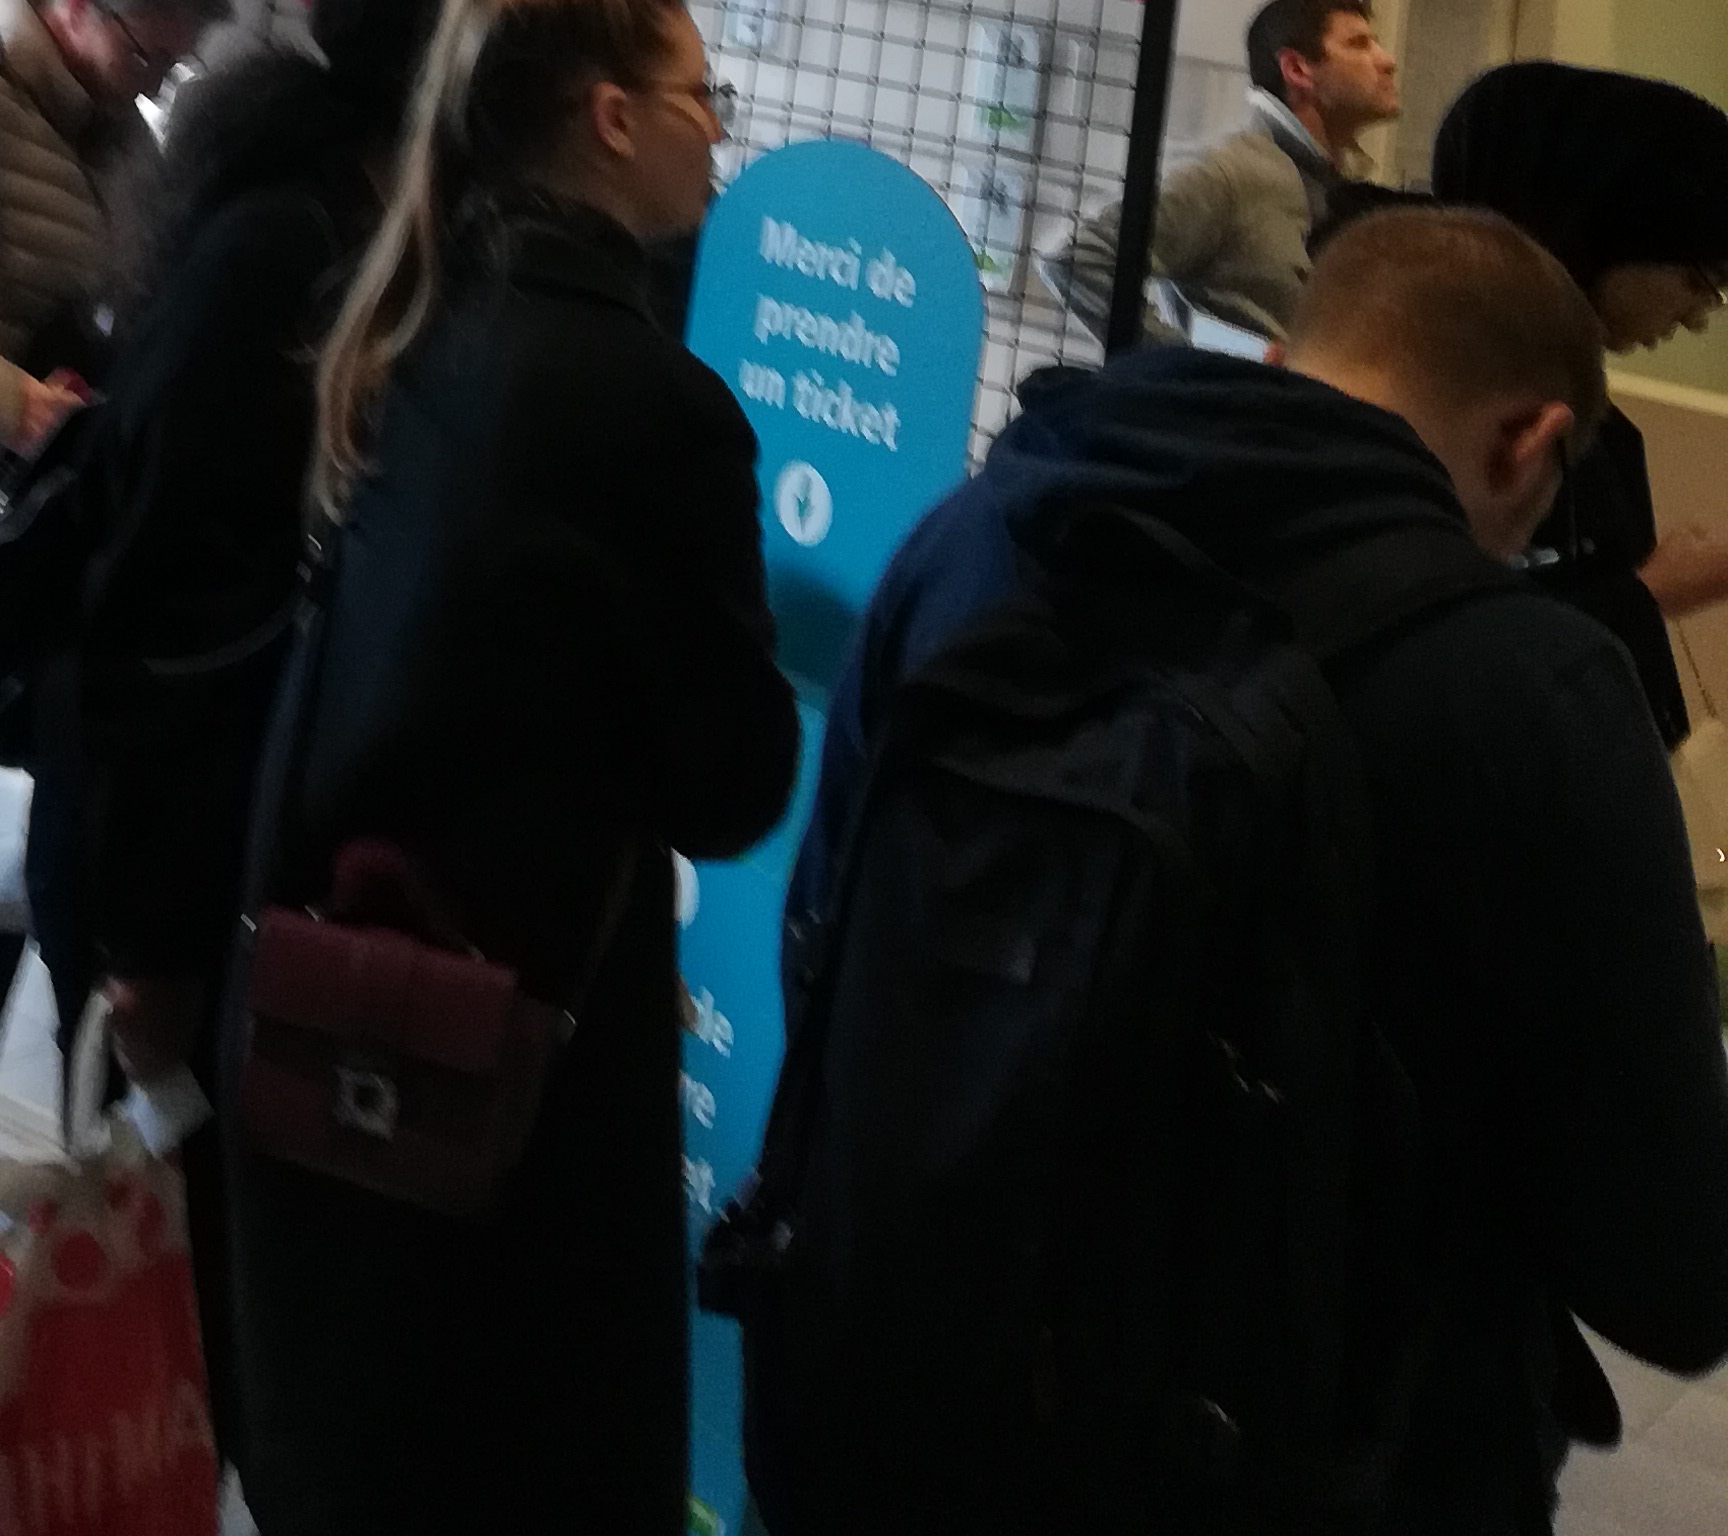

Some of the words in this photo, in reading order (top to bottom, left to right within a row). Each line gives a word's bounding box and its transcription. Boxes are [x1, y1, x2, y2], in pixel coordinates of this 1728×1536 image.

[760, 216, 862, 291] Merci
[866, 247, 917, 308] de
[754, 293, 901, 377] prendre
[738, 359, 786, 410] un
[792, 369, 901, 452] ticket
